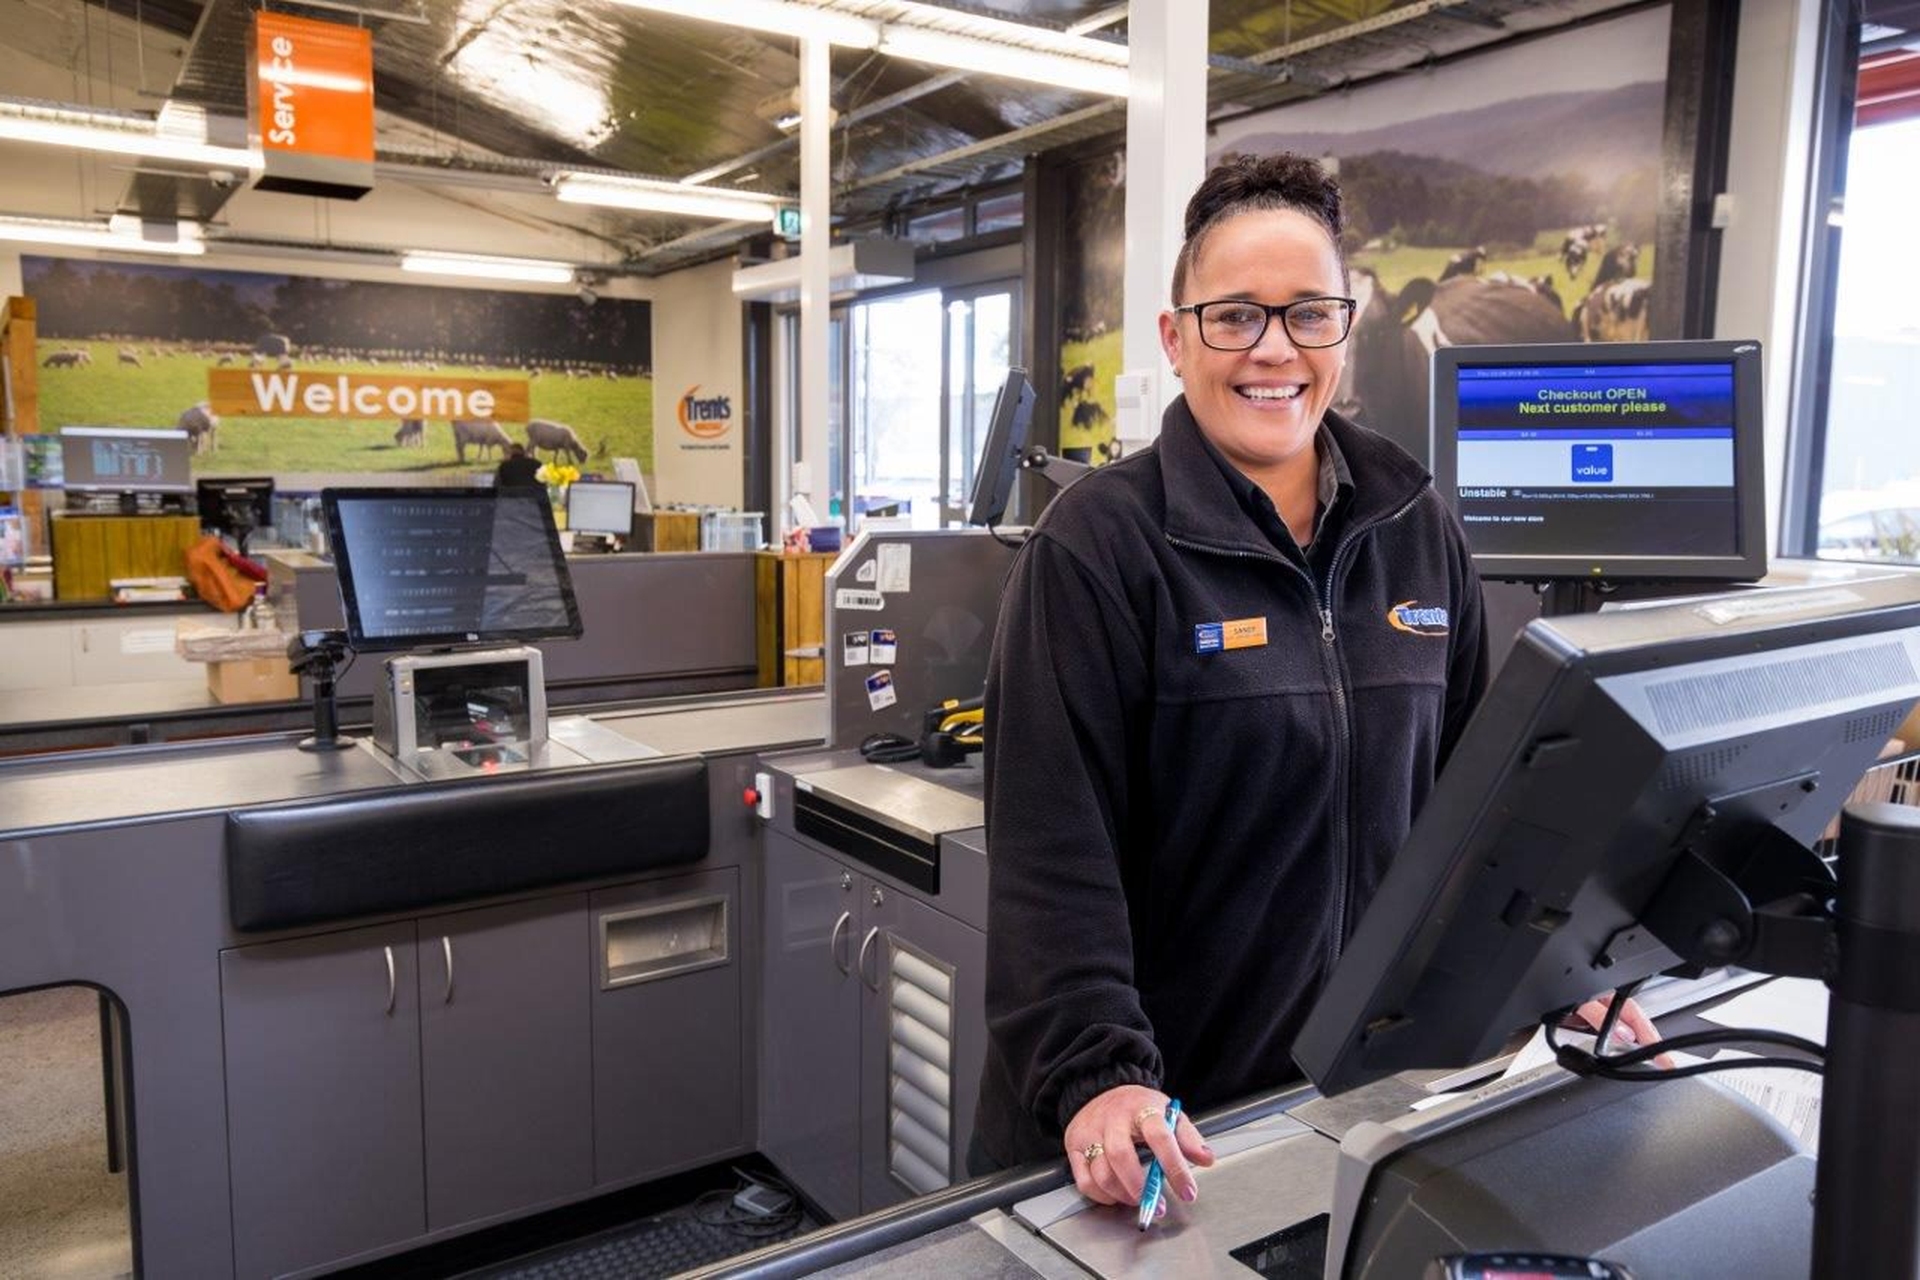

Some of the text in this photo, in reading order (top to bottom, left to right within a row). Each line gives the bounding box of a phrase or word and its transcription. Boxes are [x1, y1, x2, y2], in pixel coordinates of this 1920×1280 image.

[268, 36, 296, 146] Servce
[251, 373, 496, 418] Welcome
[1537, 388, 1647, 401] Checkout OPEN
[684, 395, 731, 421] Trents
[1519, 401, 1667, 415] Next customer please
[1575, 465, 1608, 475] value
[1459, 488, 1507, 498] Unstable
